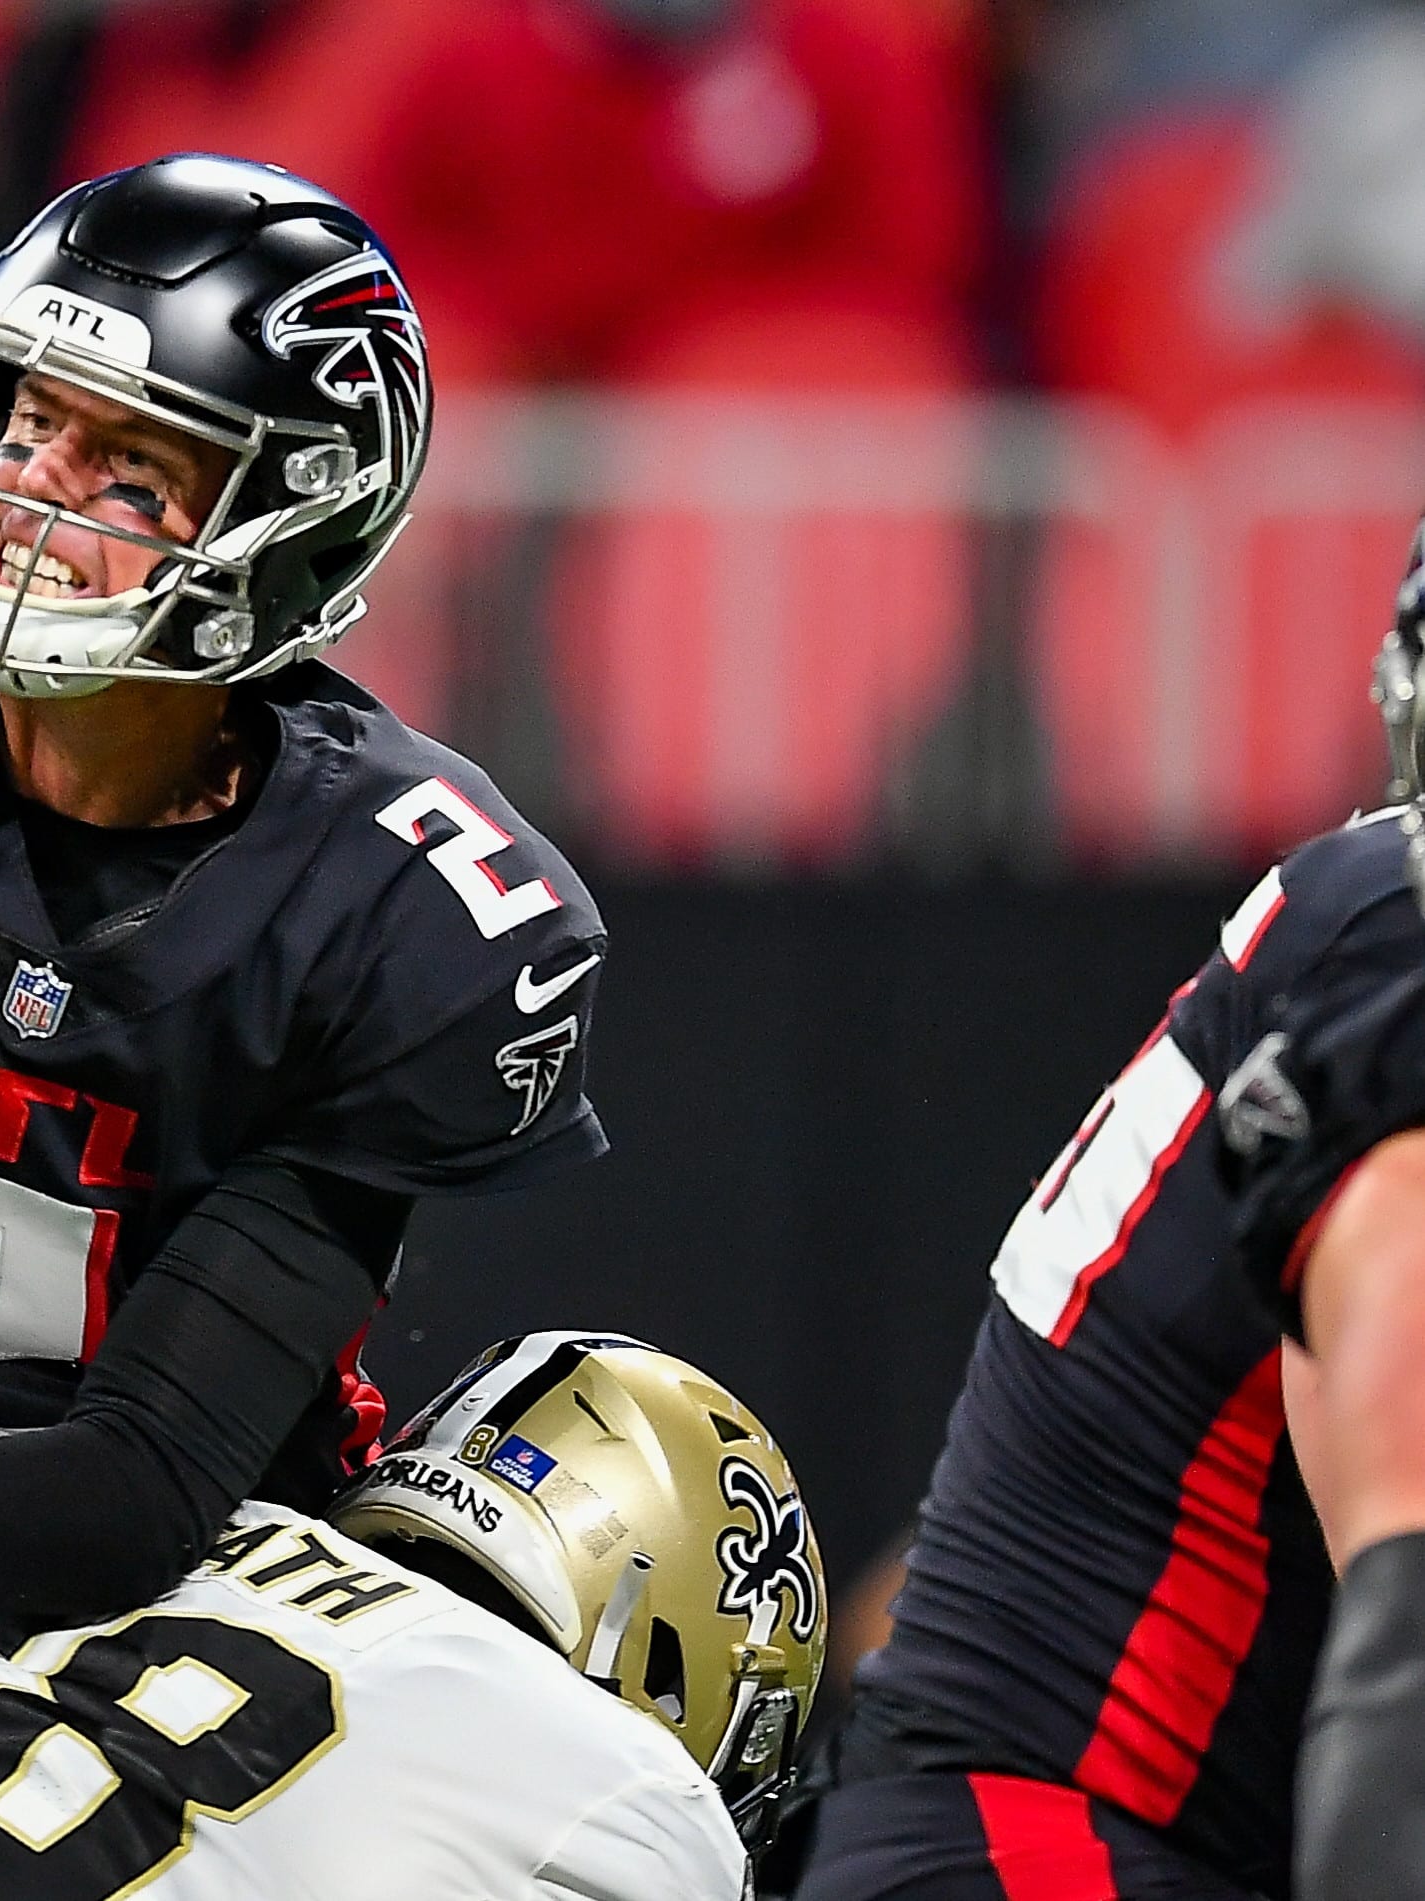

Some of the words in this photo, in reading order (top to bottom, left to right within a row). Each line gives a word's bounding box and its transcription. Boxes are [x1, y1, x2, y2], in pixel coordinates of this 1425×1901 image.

[38, 299, 106, 341] ATL
[375, 775, 564, 940] 2
[12, 991, 51, 1028] NFL
[457, 1424, 499, 1465] 8
[198, 1522, 419, 1626] ATH
